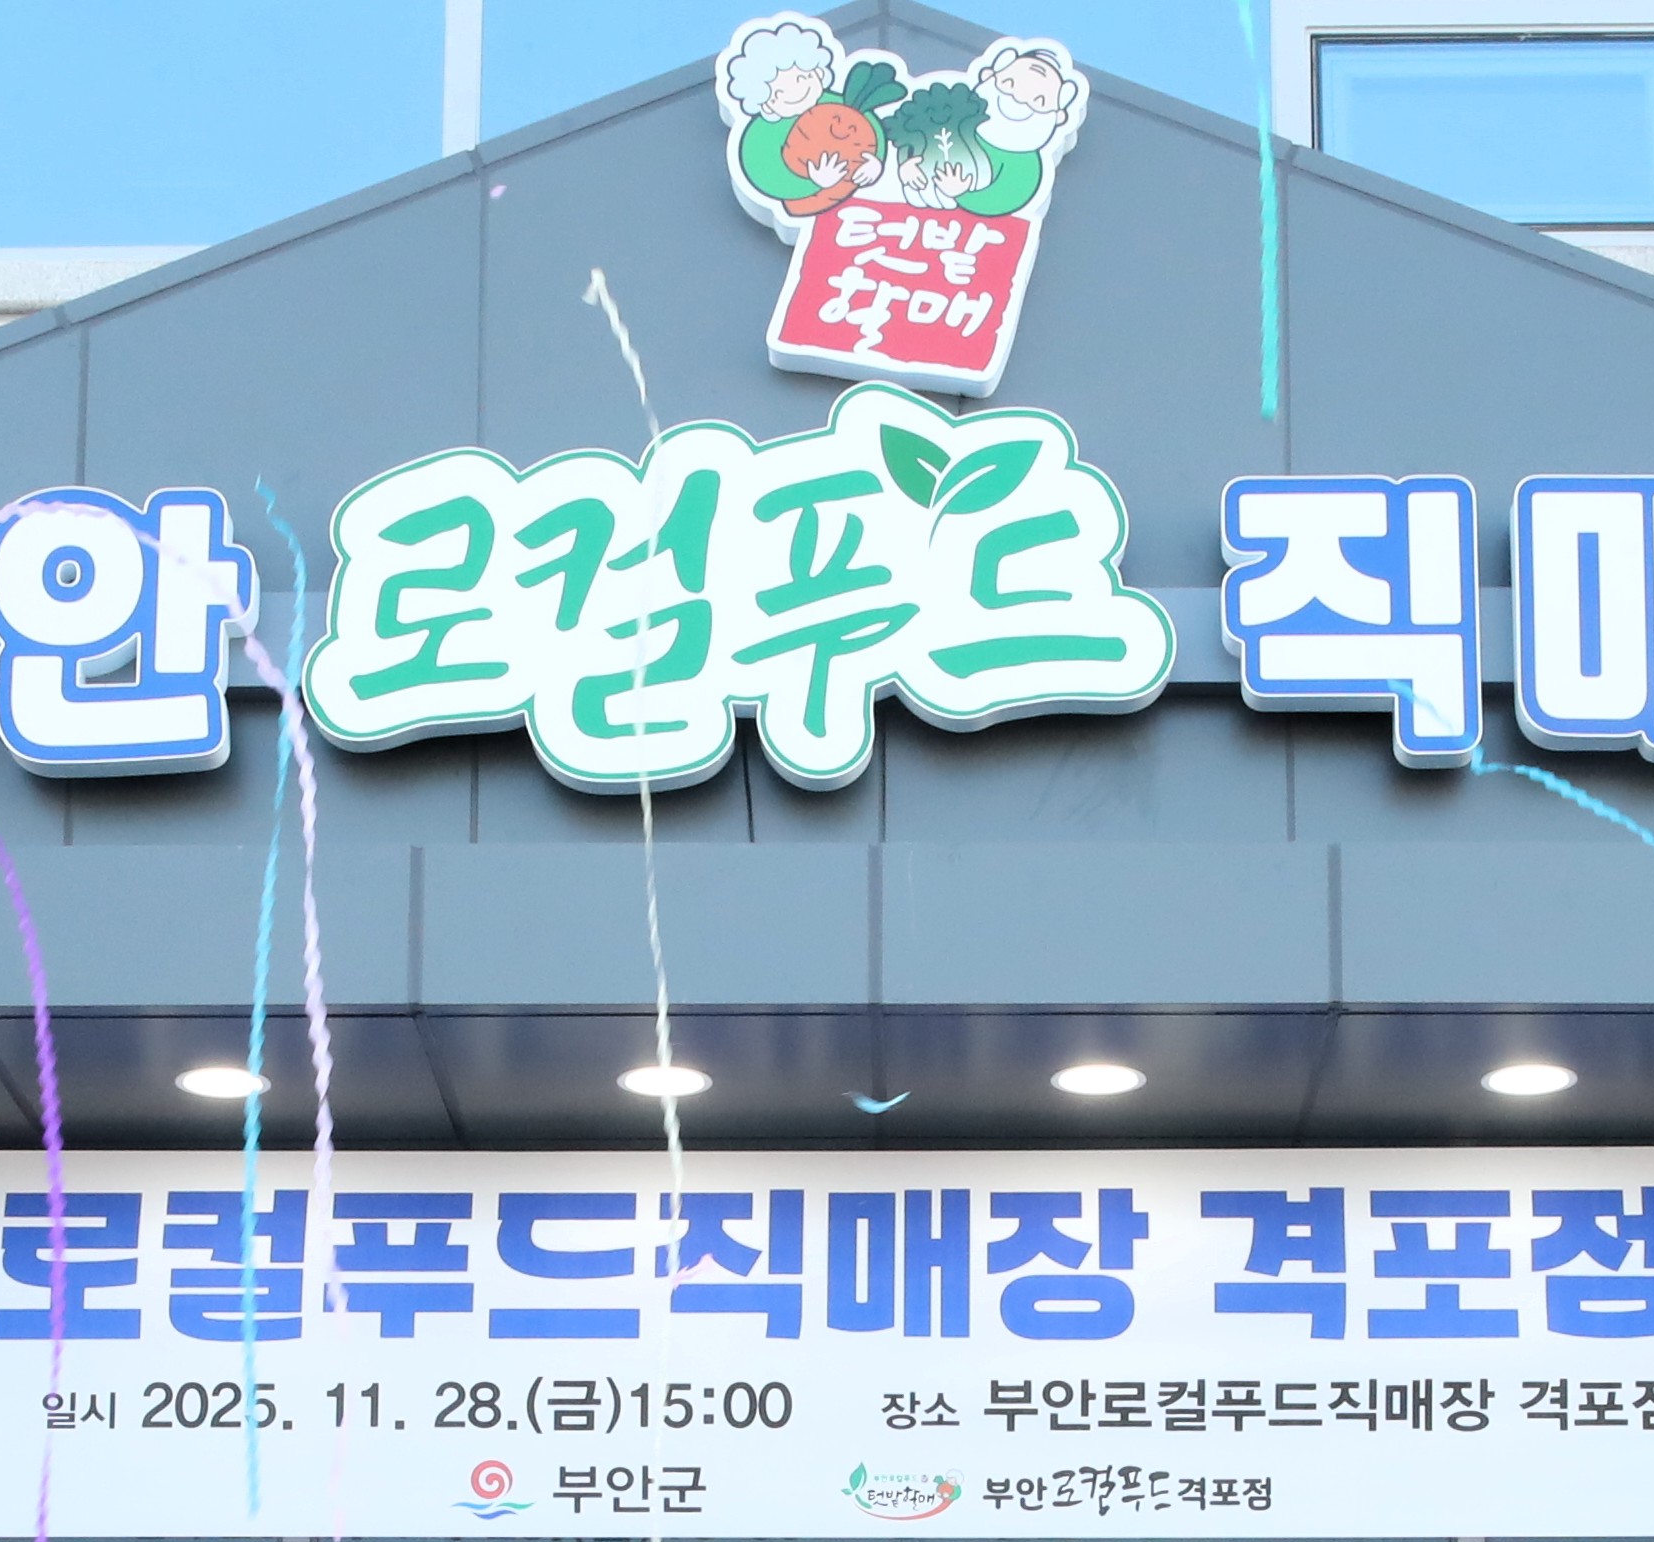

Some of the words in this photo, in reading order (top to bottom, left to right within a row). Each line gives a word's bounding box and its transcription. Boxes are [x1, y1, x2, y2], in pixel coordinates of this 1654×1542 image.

[835, 208, 1006, 285] 텃밭
[818, 267, 993, 354] 할매
[336, 450, 1141, 748] 로컬푸드
[42, 1391, 117, 1430] 일시
[141, 1380, 294, 1430] 2025.
[325, 1381, 405, 1431] 11.
[881, 1391, 961, 1428] 장소
[982, 1378, 1495, 1433] 부안로컬푸드직매장
[552, 1465, 707, 1514] 부안군
[867, 1486, 936, 1511] 텃밭할매
